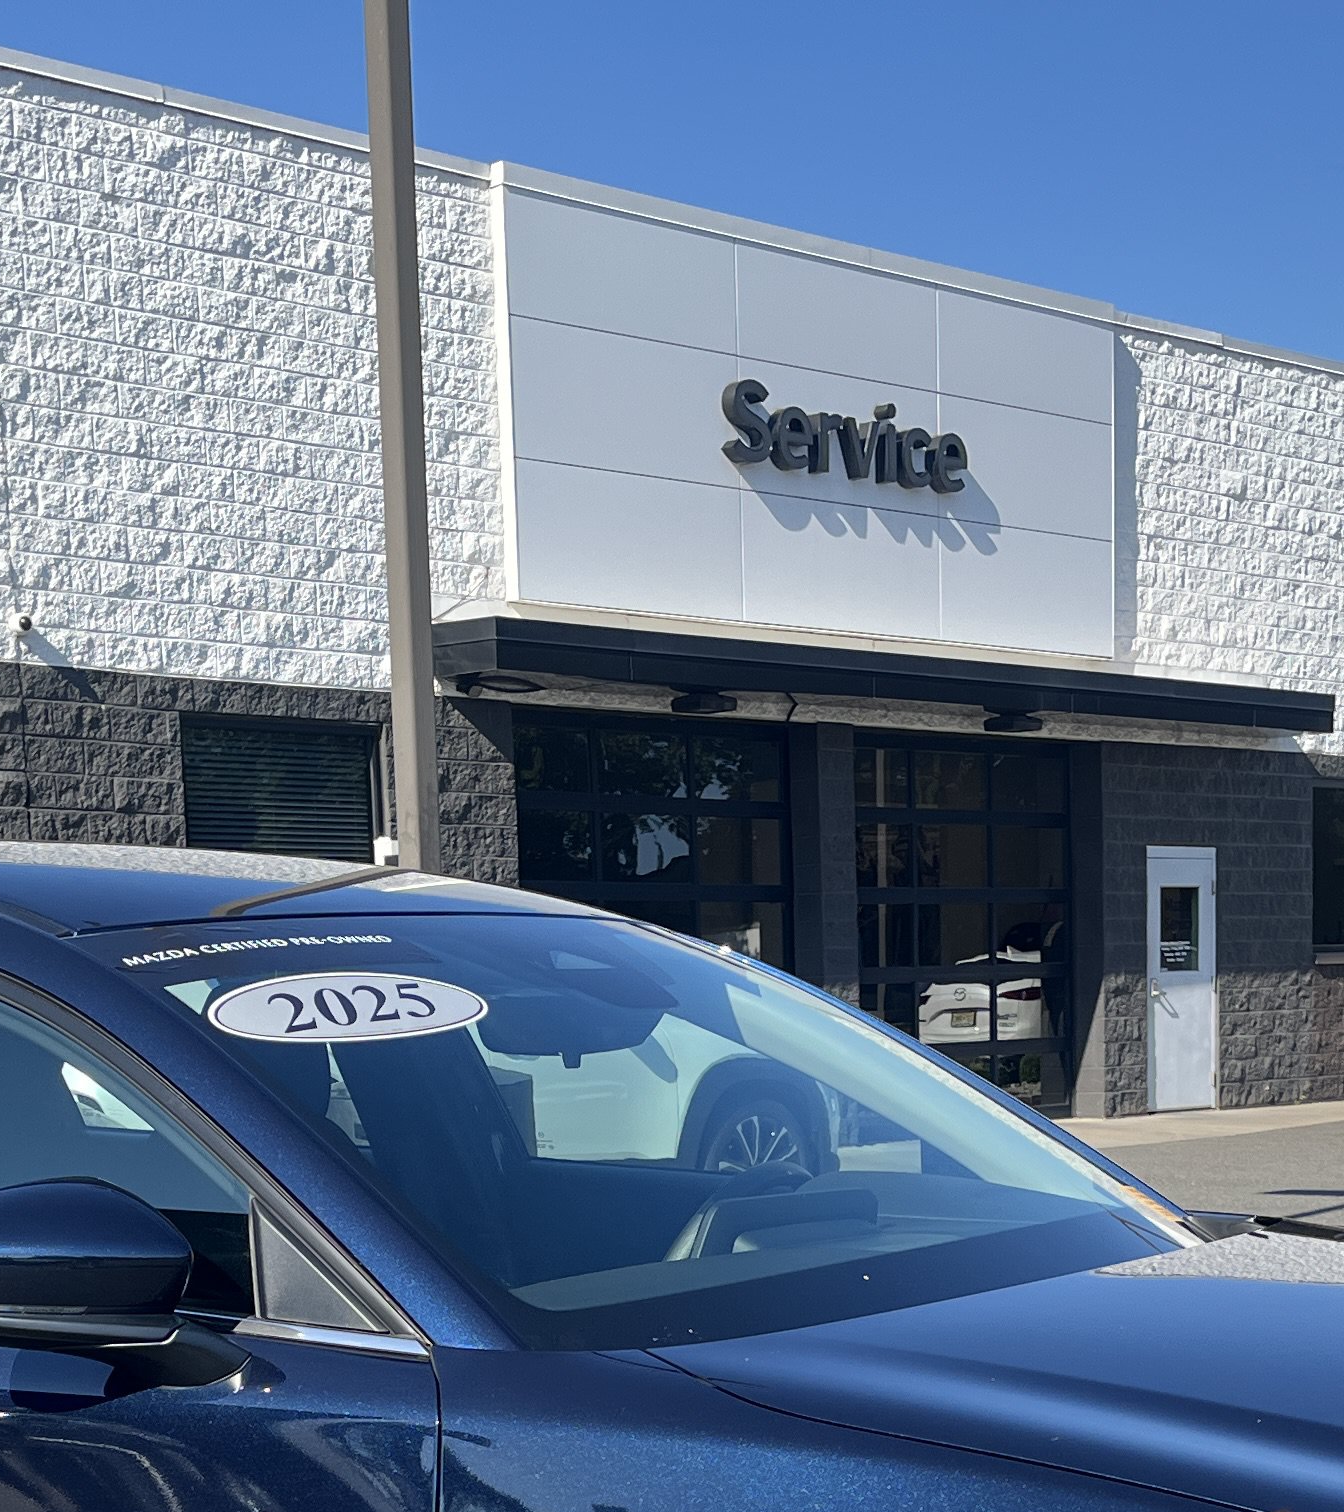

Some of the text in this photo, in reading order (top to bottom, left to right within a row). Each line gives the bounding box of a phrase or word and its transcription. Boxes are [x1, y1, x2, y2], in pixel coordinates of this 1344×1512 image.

[721, 378, 969, 494] Service
[122, 935, 392, 967] MAZDA CERTIFIED PRE-OWNED
[268, 983, 436, 1033] 2025
